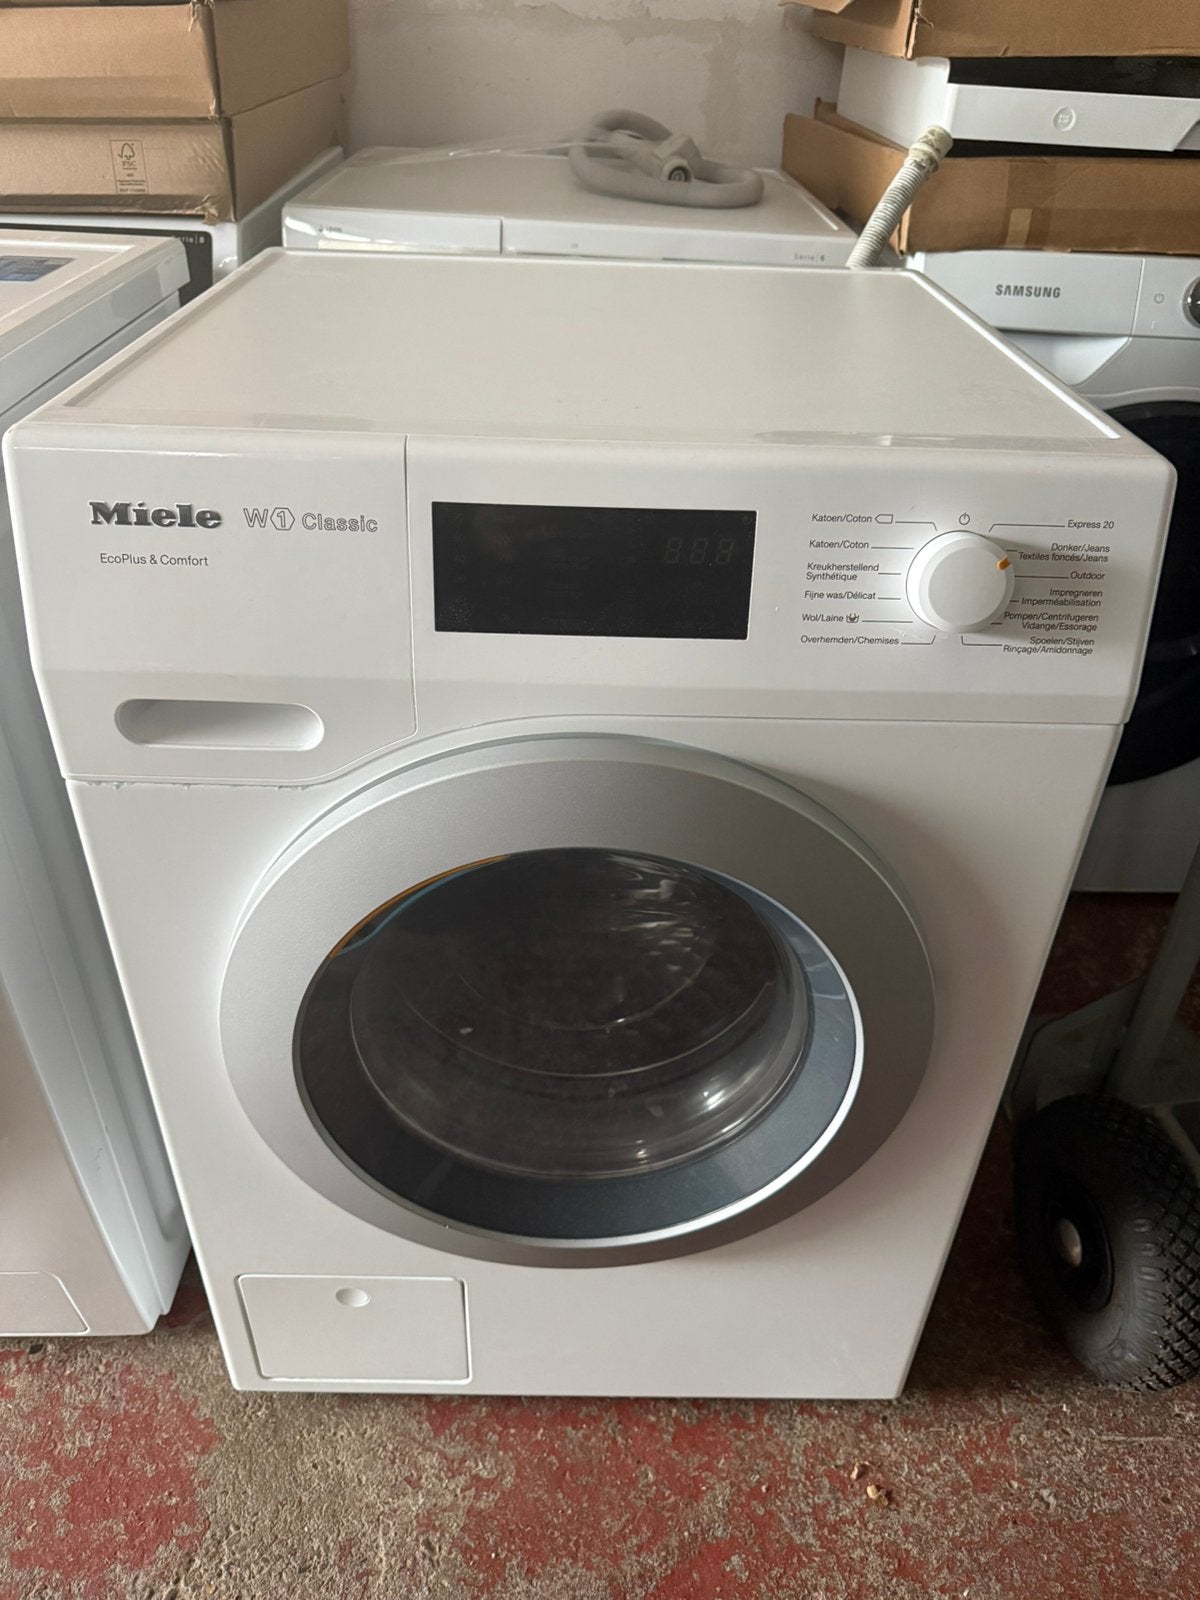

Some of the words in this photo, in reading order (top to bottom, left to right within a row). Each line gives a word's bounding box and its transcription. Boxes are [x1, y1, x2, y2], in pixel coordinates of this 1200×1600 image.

[995, 284, 1061, 298] SAMSUNG
[89, 501, 223, 529] Miele
[302, 512, 379, 532] Classic
[811, 513, 873, 523] Katoen/Coton
[1067, 519, 1101, 530] Express
[1103, 520, 1115, 530] 20
[809, 539, 870, 549] Katoen/Coton
[1051, 543, 1111, 553] Donker/Jeans
[99, 553, 147, 565] EcoPlus
[149, 554, 158, 565] &
[160, 554, 209, 567] Comfort
[1018, 552, 1050, 561] Textiles
[1051, 553, 1109, 562] foncés/Jeans
[806, 562, 880, 572] Kreukherstellend
[806, 571, 858, 582] Synthétique
[1070, 571, 1106, 581] Outdoor
[804, 590, 825, 600] Fijne
[826, 590, 876, 600] was/Délicat
[1049, 588, 1104, 598] Impregneren
[1021, 597, 1102, 607] Imperméabilisation
[801, 613, 844, 622] Wol/Laine
[1003, 611, 1099, 622] Pompen/Centrifugeren
[1021, 622, 1098, 633] Vidange/Essorage
[800, 634, 900, 645] Overhemden/Chemises
[1029, 636, 1095, 648] Spoelen/Stijven
[1003, 645, 1094, 656] Rinçage/Amidonnage
